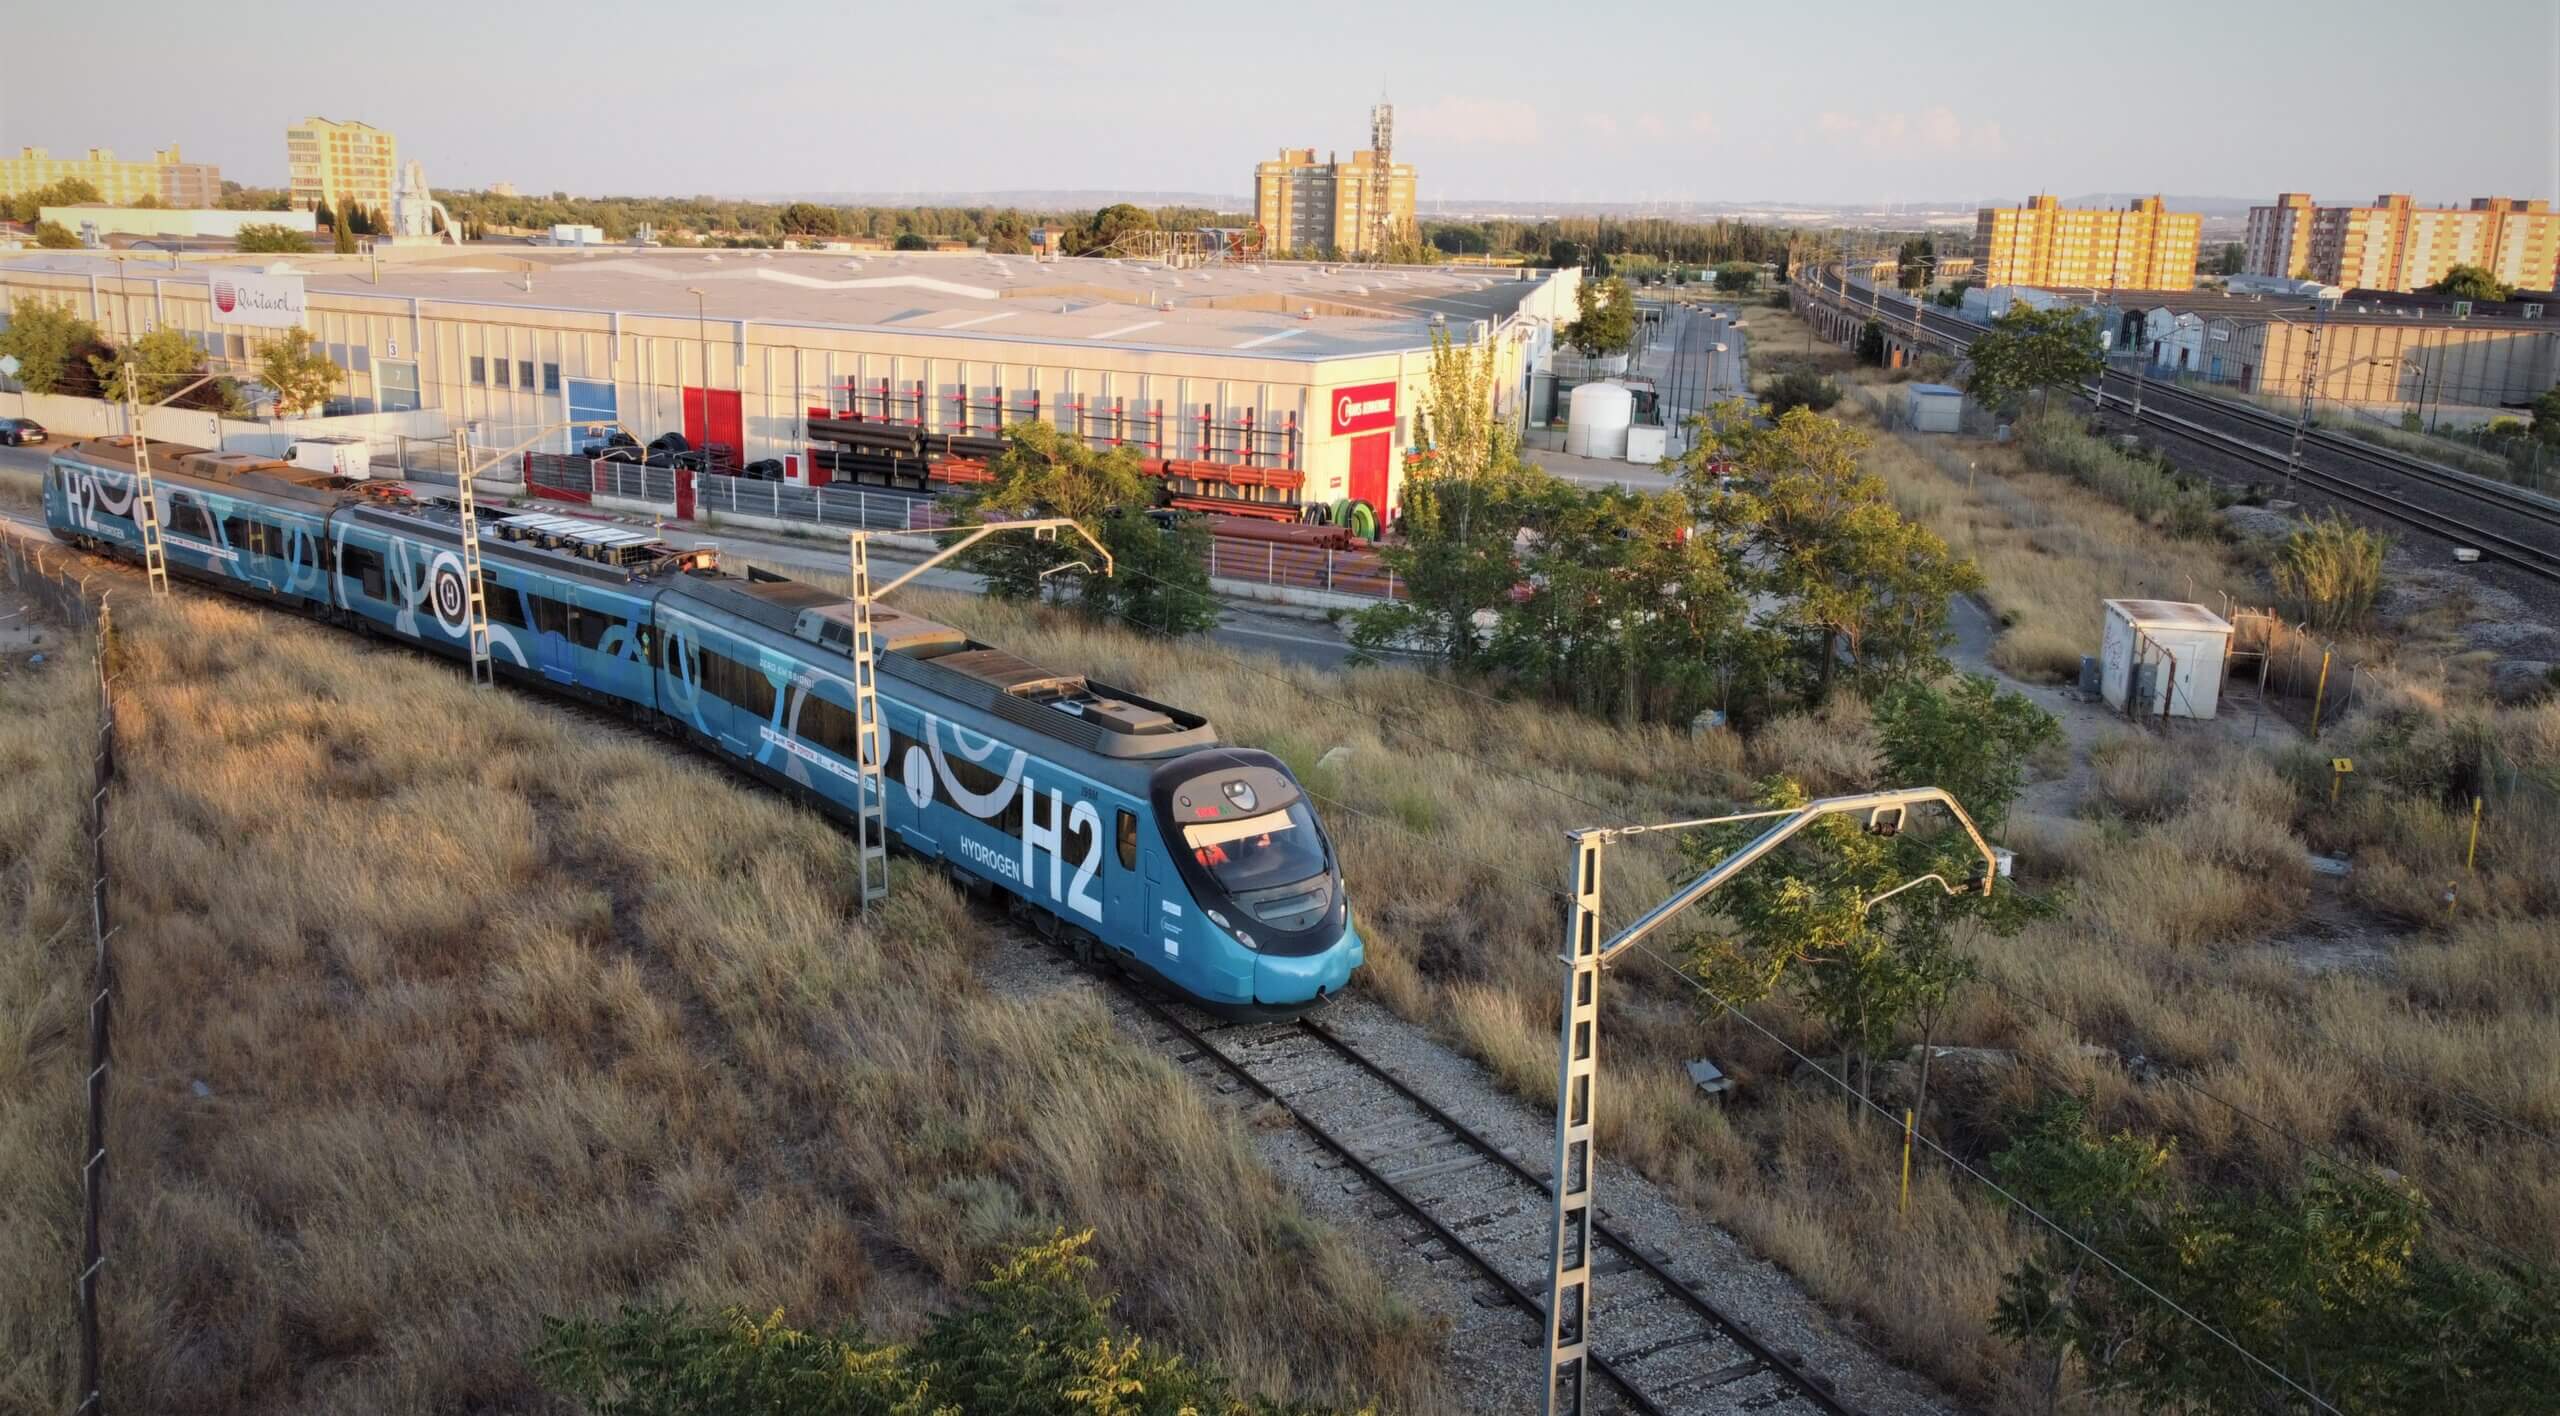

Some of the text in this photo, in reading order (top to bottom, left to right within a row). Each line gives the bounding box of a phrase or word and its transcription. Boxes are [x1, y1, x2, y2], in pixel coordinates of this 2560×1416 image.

[238, 287, 289, 311] Quitasol
[64, 470, 99, 532] H2
[446, 584, 455, 607] H
[960, 834, 1020, 882] HYDROGEN
[1022, 775, 1103, 924] H2
